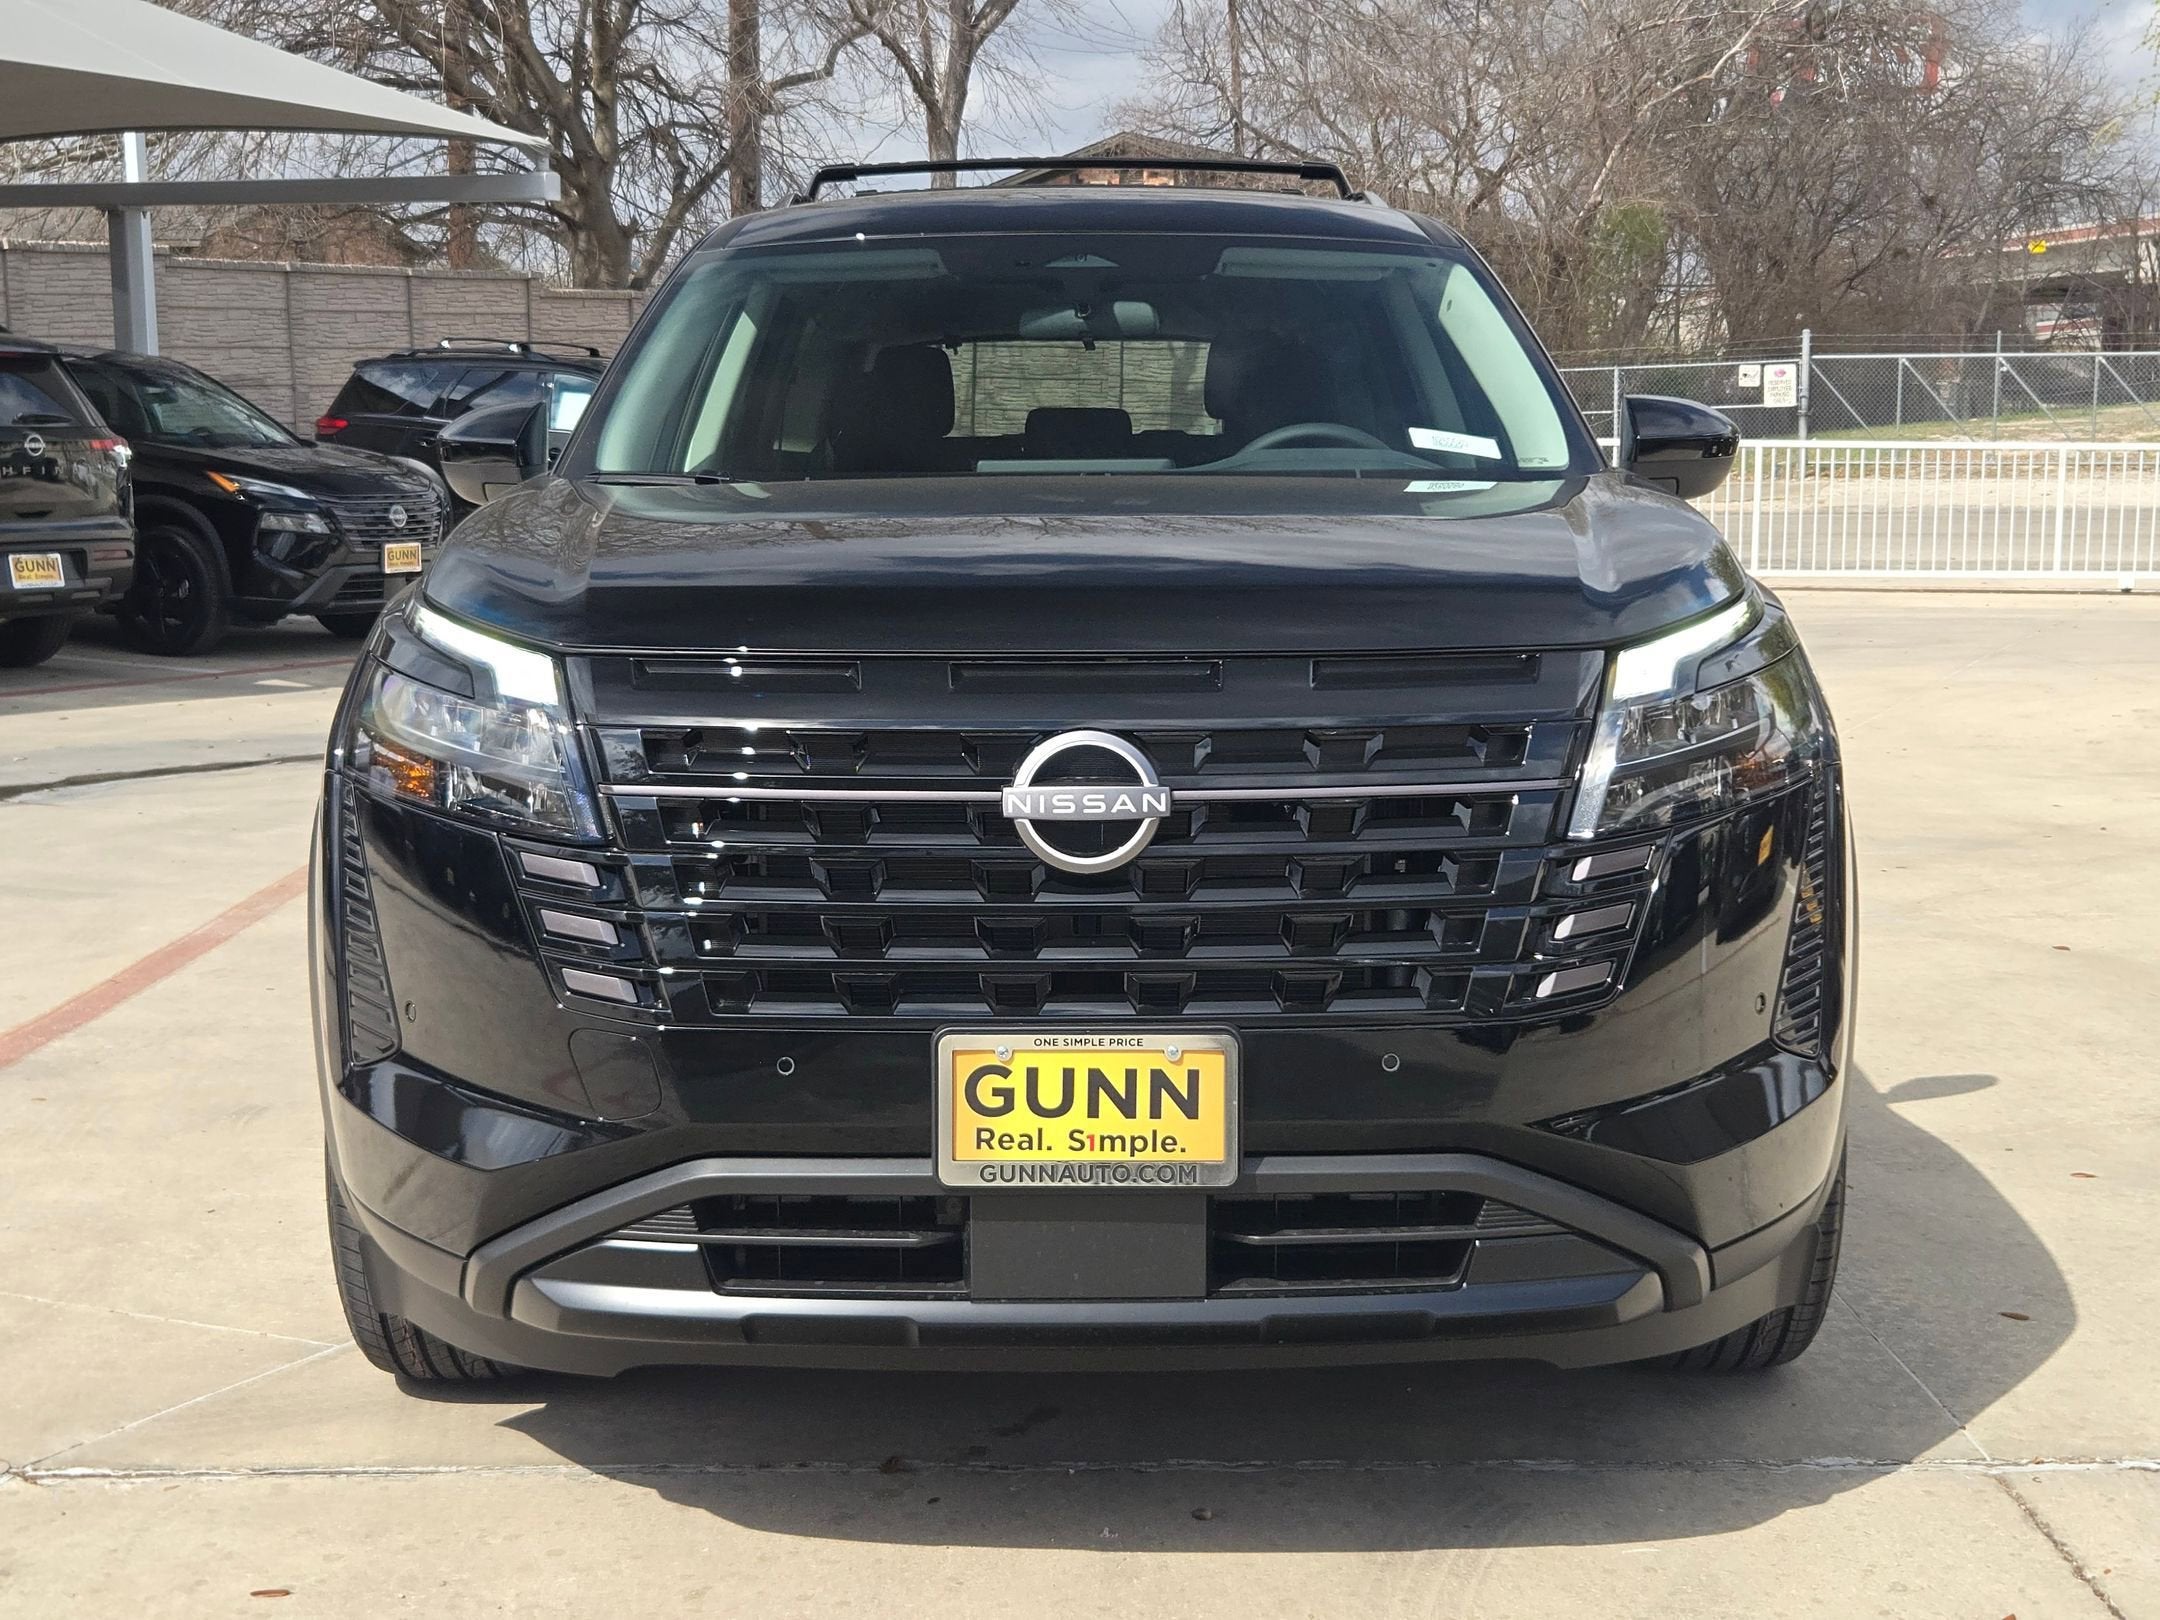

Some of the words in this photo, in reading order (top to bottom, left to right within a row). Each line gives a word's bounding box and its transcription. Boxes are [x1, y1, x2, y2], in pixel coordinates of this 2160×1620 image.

[388, 549, 417, 561] GUNN
[15, 559, 56, 572] GUNN
[1007, 792, 1166, 814] NISSAN
[1033, 1038, 1059, 1047] ONE
[1063, 1038, 1105, 1047] SIMPLE
[1109, 1038, 1144, 1047] PRICE
[964, 1064, 1200, 1120] GUNN
[976, 1127, 1052, 1151] Real.
[979, 1165, 1197, 1184] GUNNAUTO.COM
